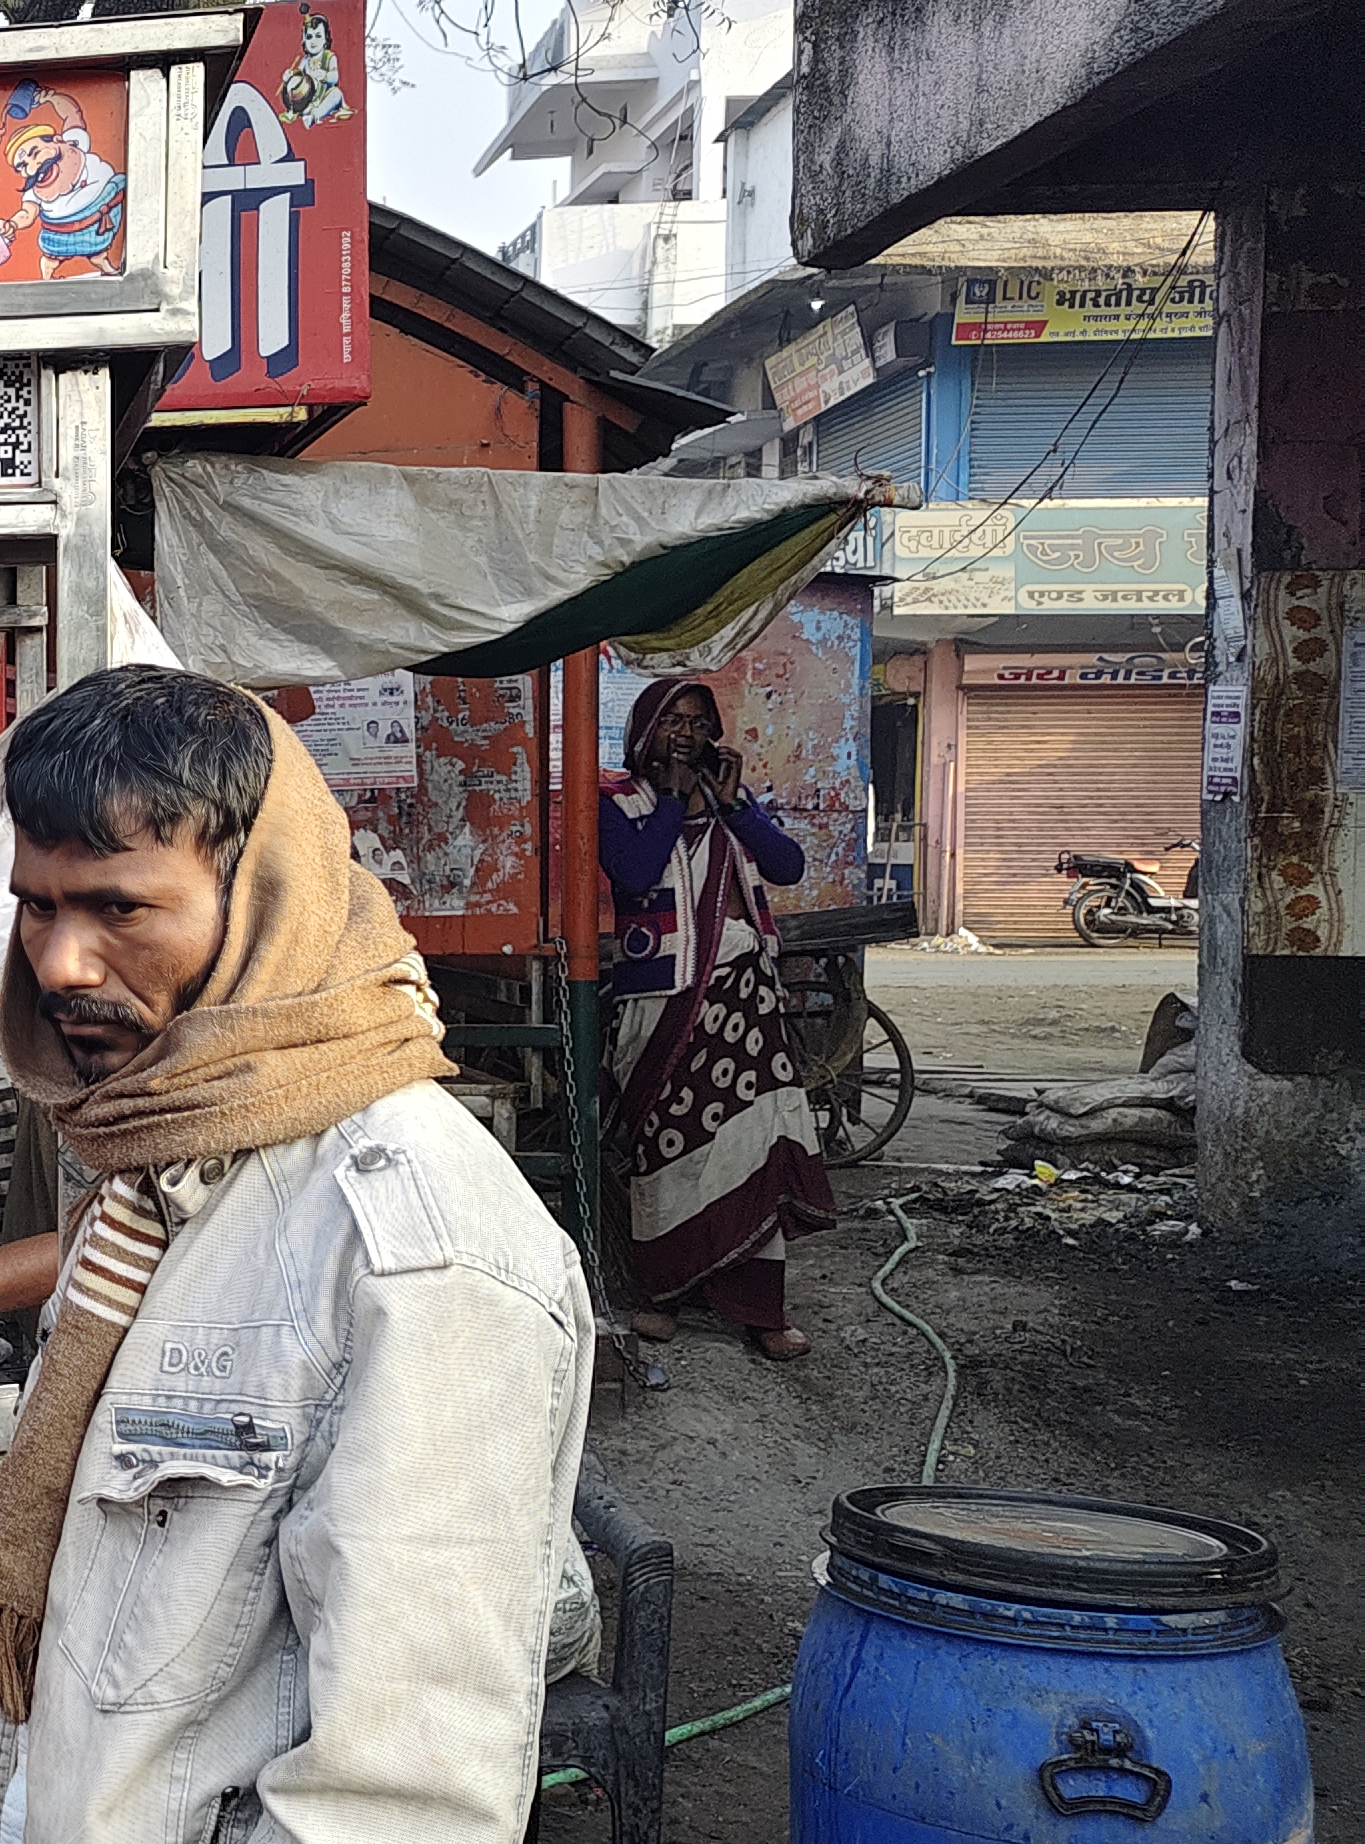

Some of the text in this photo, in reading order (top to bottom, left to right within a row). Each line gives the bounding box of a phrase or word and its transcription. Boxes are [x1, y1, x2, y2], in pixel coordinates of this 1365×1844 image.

[1002, 279, 1042, 302] LIC
[1055, 281, 1160, 309] भारतीय
[899, 514, 1009, 553] दवाईयाँ
[1019, 525, 1167, 574] जय
[1027, 588, 1187, 605] एण्ड जनरल
[996, 653, 1206, 682] जय मेडिक
[159, 1340, 235, 1378] D&G
